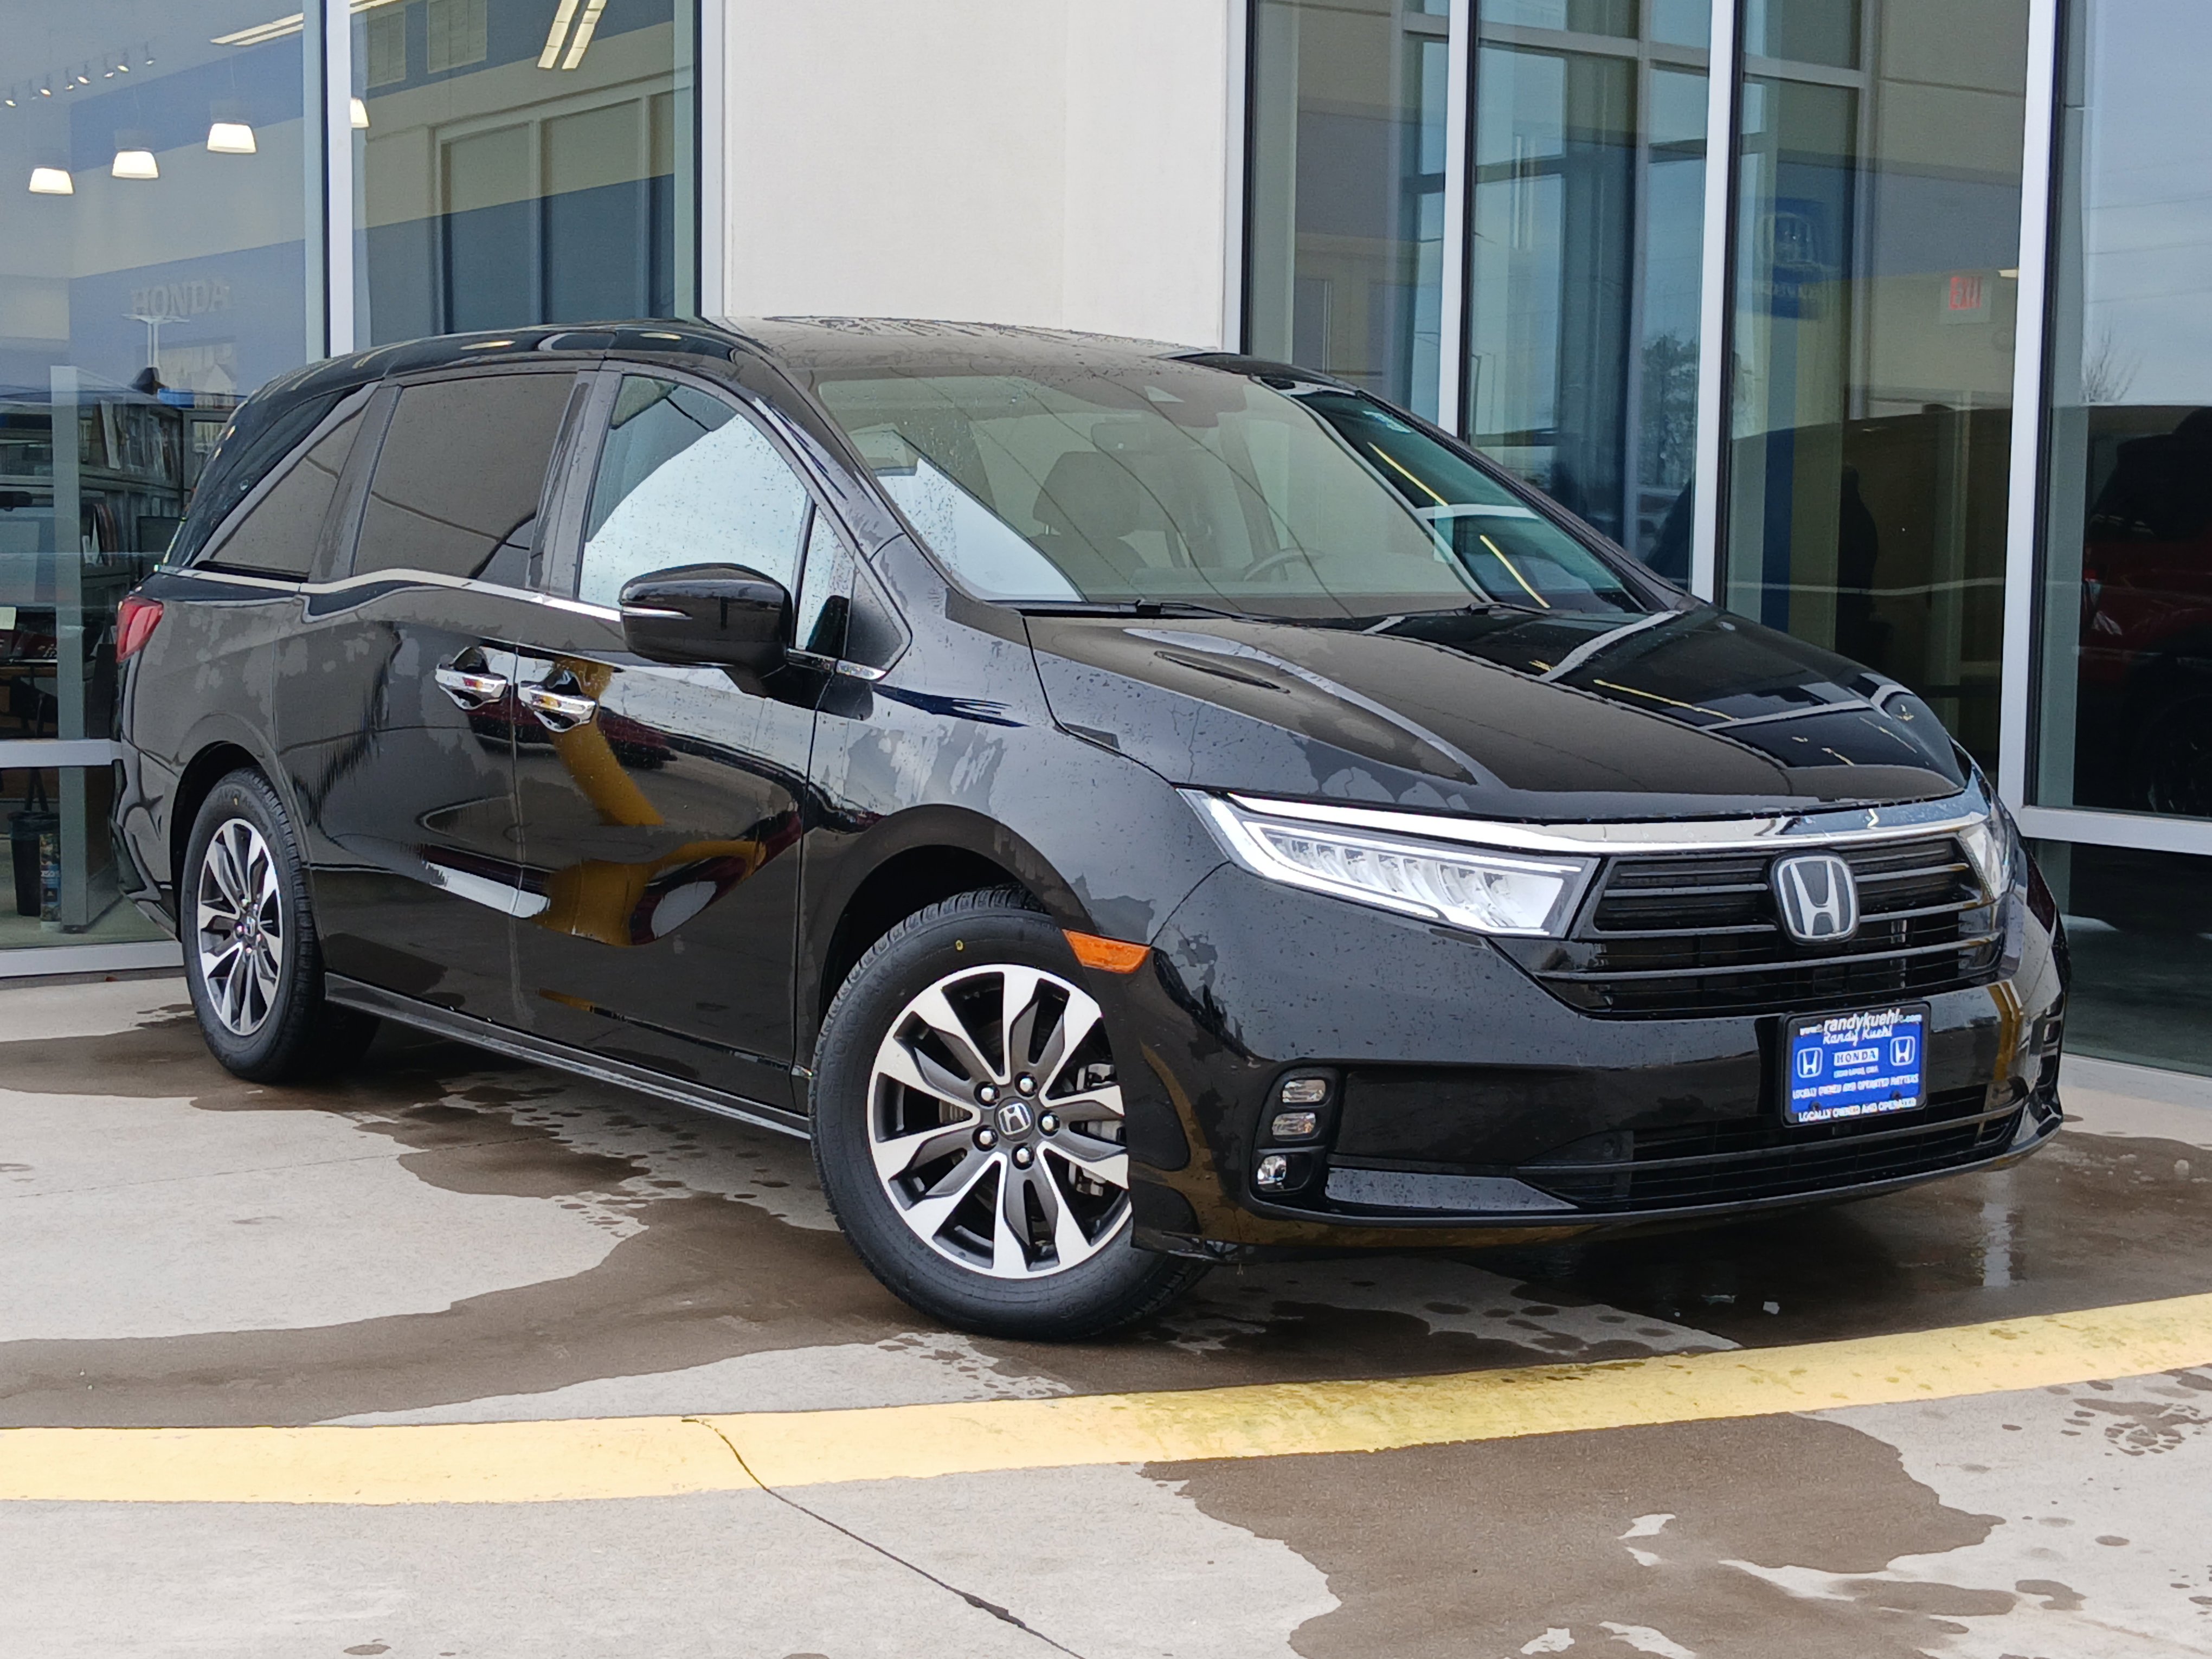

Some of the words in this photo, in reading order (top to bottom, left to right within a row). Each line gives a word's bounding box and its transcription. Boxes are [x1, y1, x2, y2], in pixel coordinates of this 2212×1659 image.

[131, 279, 230, 317] HONDA
[1950, 276, 1983, 311] EXIT
[1836, 1050, 1876, 1063] HONDA
[1798, 1108, 1831, 1122] LOCALLY
